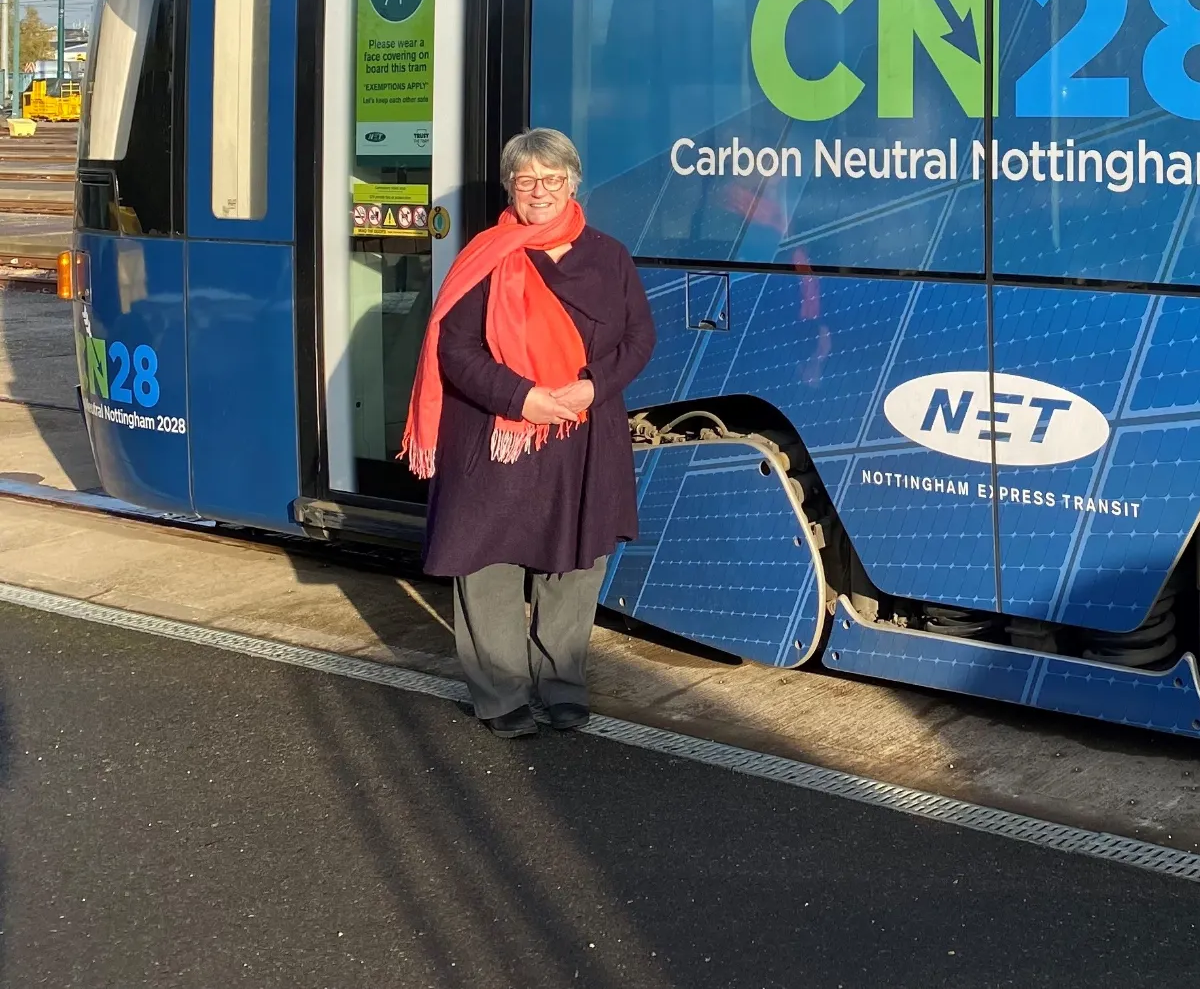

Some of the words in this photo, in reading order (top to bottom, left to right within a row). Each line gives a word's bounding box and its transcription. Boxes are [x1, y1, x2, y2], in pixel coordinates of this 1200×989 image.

[368, 39, 395, 49] Please
[398, 39, 417, 48] wear
[419, 39, 425, 47] a
[364, 51, 380, 62] face
[382, 50, 416, 62] covering
[418, 51, 429, 59] on
[366, 63, 389, 73] board
[391, 63, 406, 73] this
[408, 63, 427, 72] tram
[376, 97, 388, 105] keep
[670, 137, 802, 178] Carbon
[815, 138, 957, 180] Neutral
[104, 405, 155, 430] Nottingham
[157, 415, 186, 434] 2028
[920, 388, 1071, 444] NET
[862, 469, 969, 496] NOTTINGHAM
[1062, 494, 1140, 518] TRANSIT
